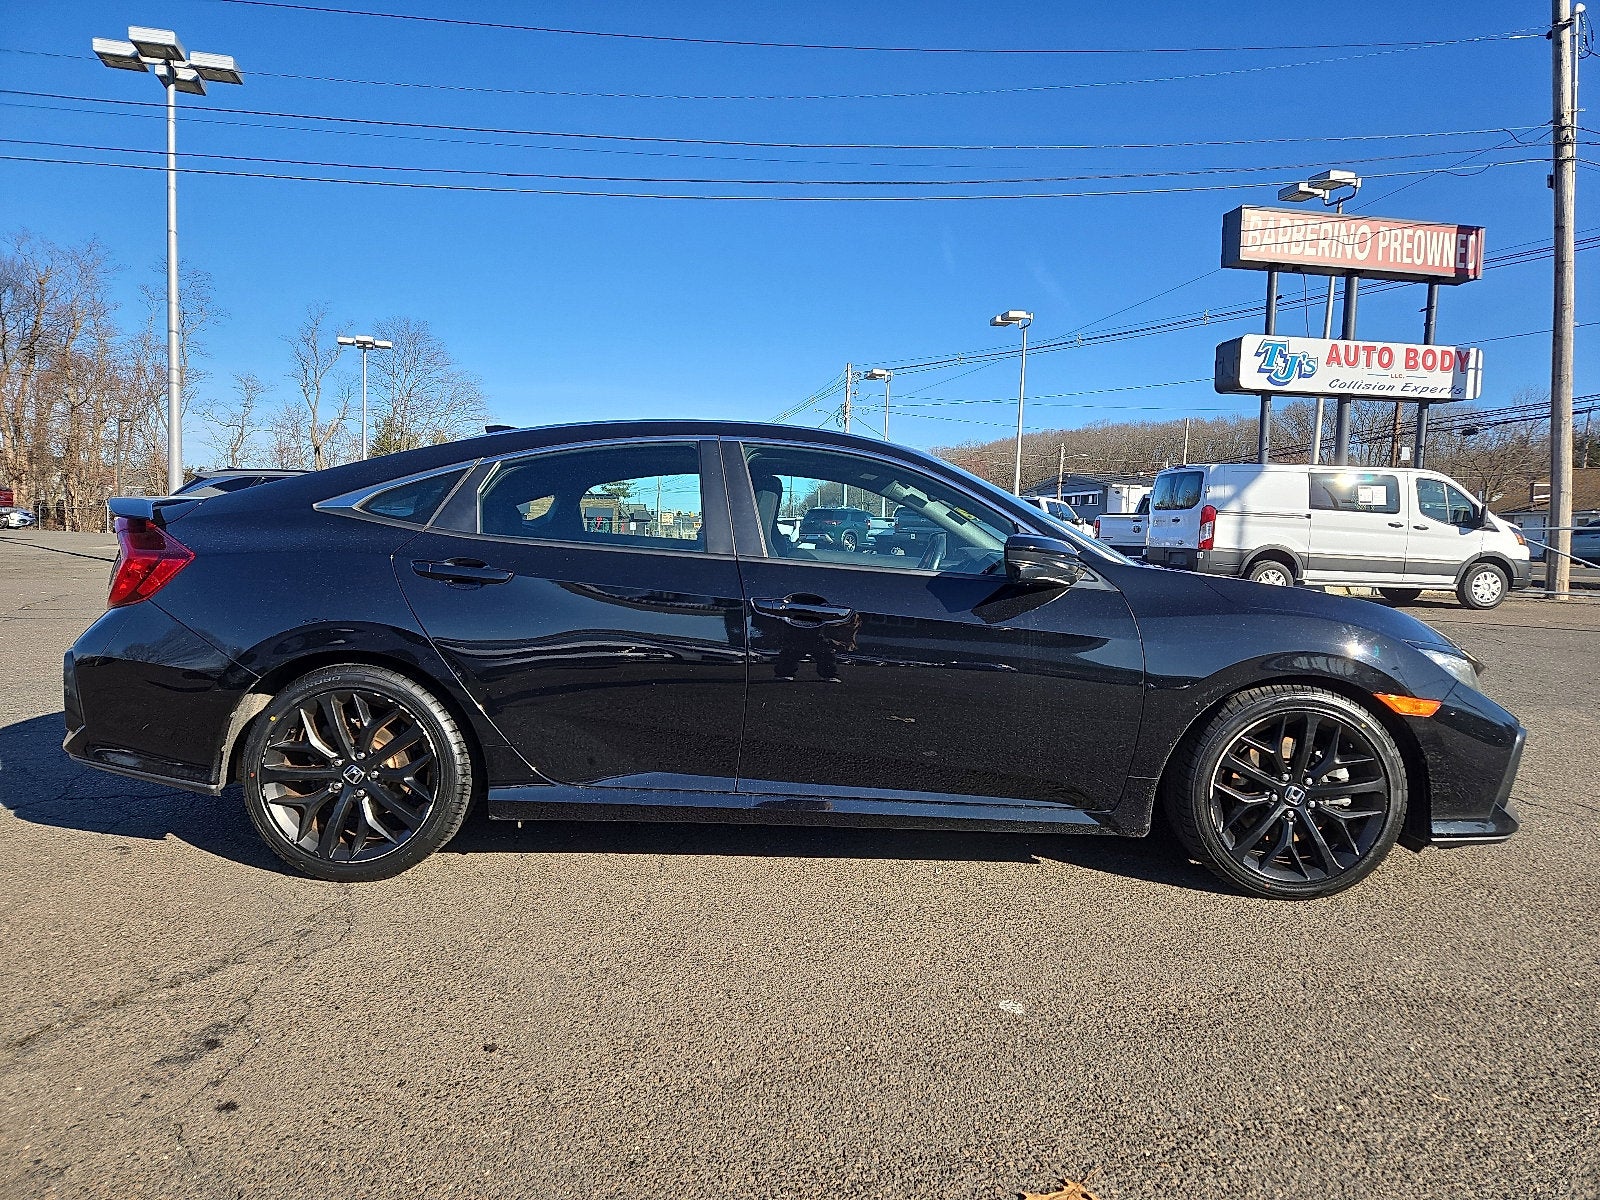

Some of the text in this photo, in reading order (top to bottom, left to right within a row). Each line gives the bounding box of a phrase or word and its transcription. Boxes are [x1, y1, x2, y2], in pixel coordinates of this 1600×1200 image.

[1247, 214, 1478, 270] BARBERINO PREOWNED
[1325, 343, 1471, 373] AUTO BODY
[1328, 378, 1465, 395] Collision Experts
